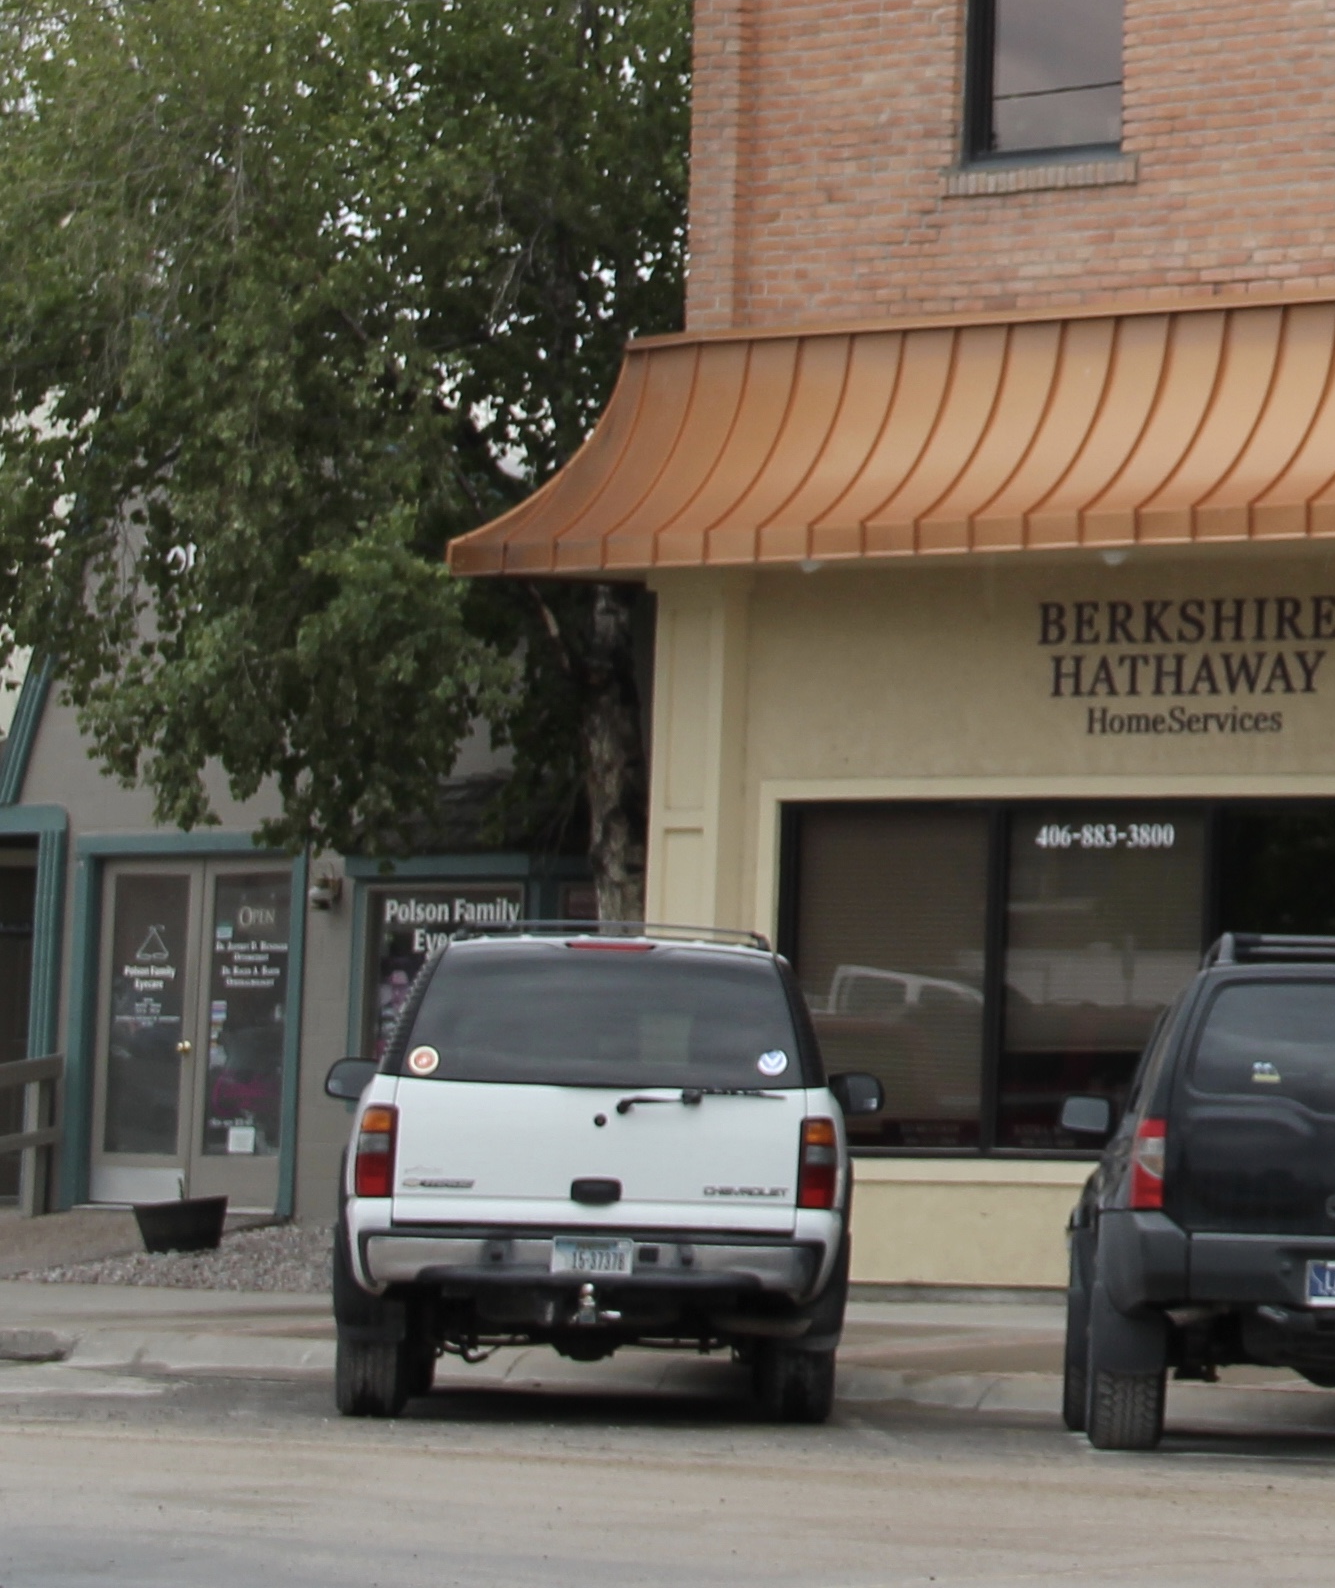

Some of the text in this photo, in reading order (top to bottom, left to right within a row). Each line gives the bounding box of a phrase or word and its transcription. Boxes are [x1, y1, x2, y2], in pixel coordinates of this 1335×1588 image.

[1050, 650, 1326, 698] HATHAWAY
[1086, 706, 1282, 735] HomeServices
[1035, 823, 1175, 849] 406-883-3800
[385, 897, 520, 928] Polson Family
